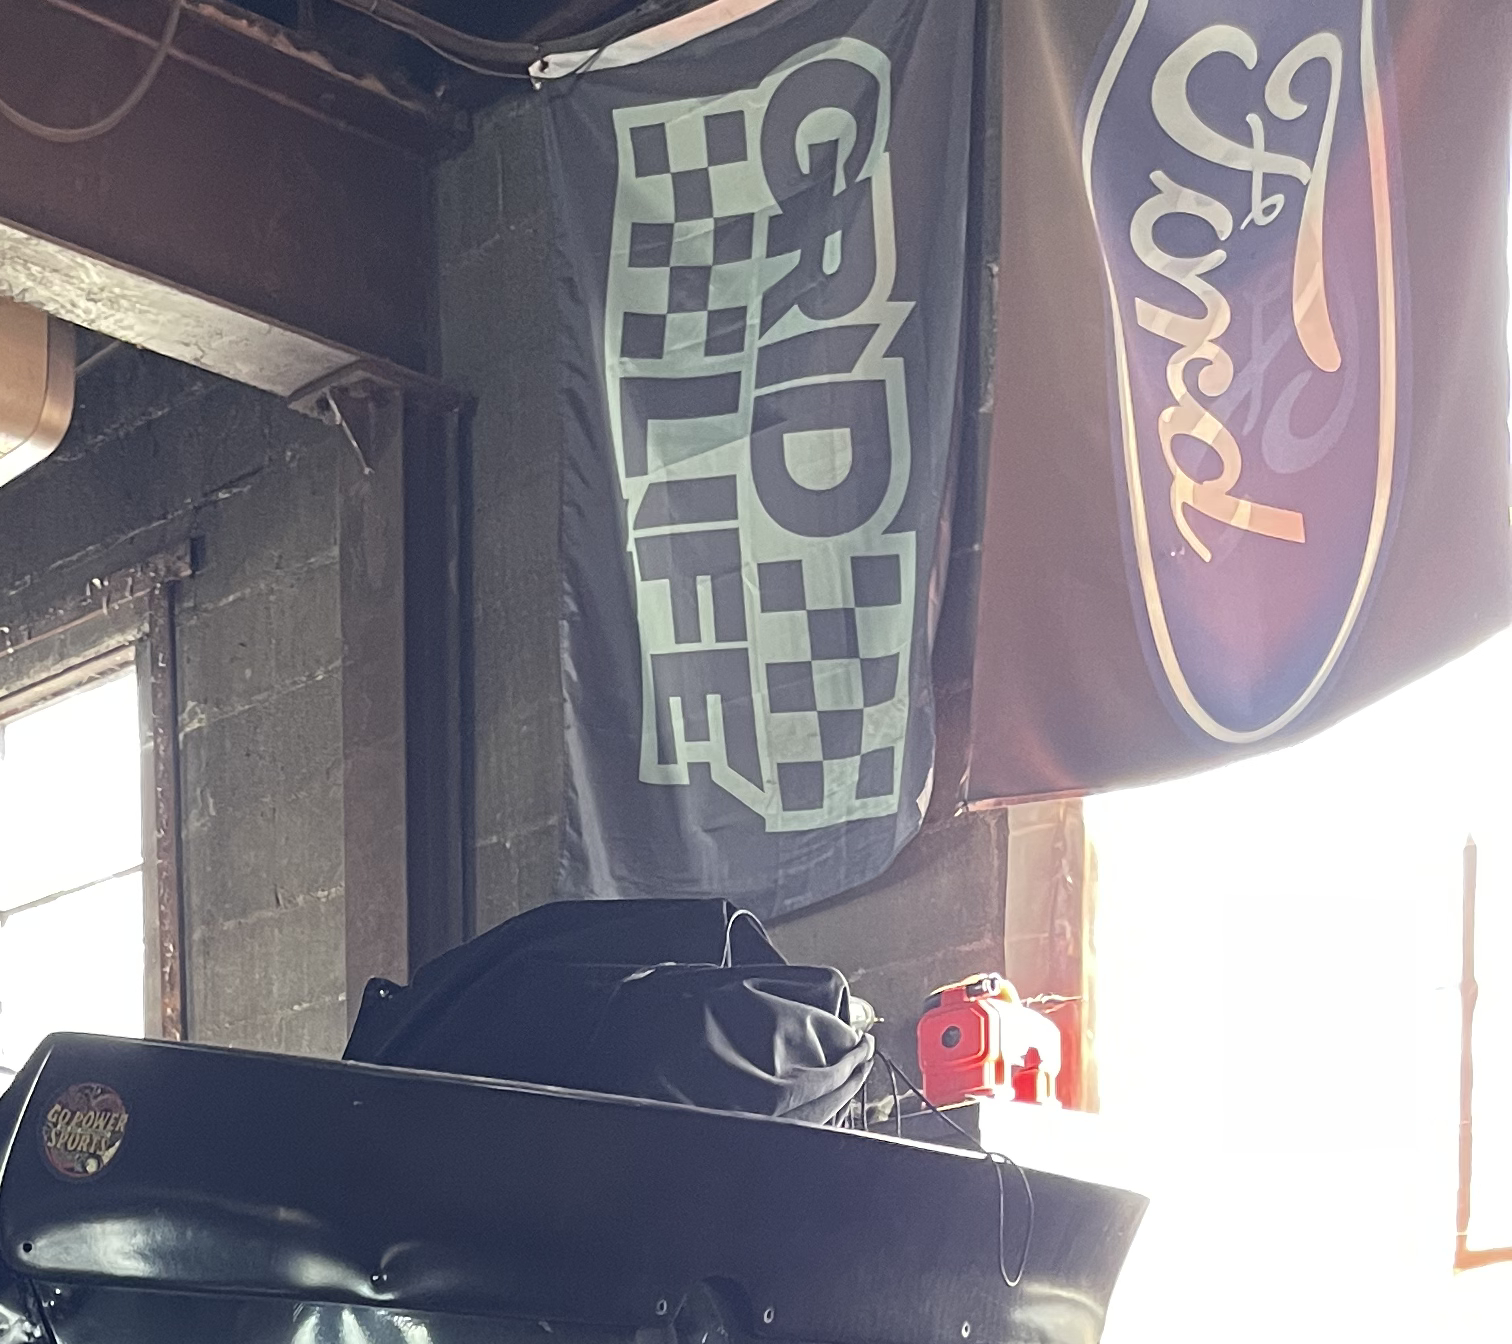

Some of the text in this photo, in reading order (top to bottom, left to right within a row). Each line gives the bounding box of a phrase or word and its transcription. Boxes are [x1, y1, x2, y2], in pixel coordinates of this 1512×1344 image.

[749, 57, 894, 538] GRID
[1131, 23, 1343, 563] Ford
[618, 370, 765, 798] LIFE
[47, 1103, 129, 1132] GO POWER
[47, 1129, 111, 1154] SPORTS
